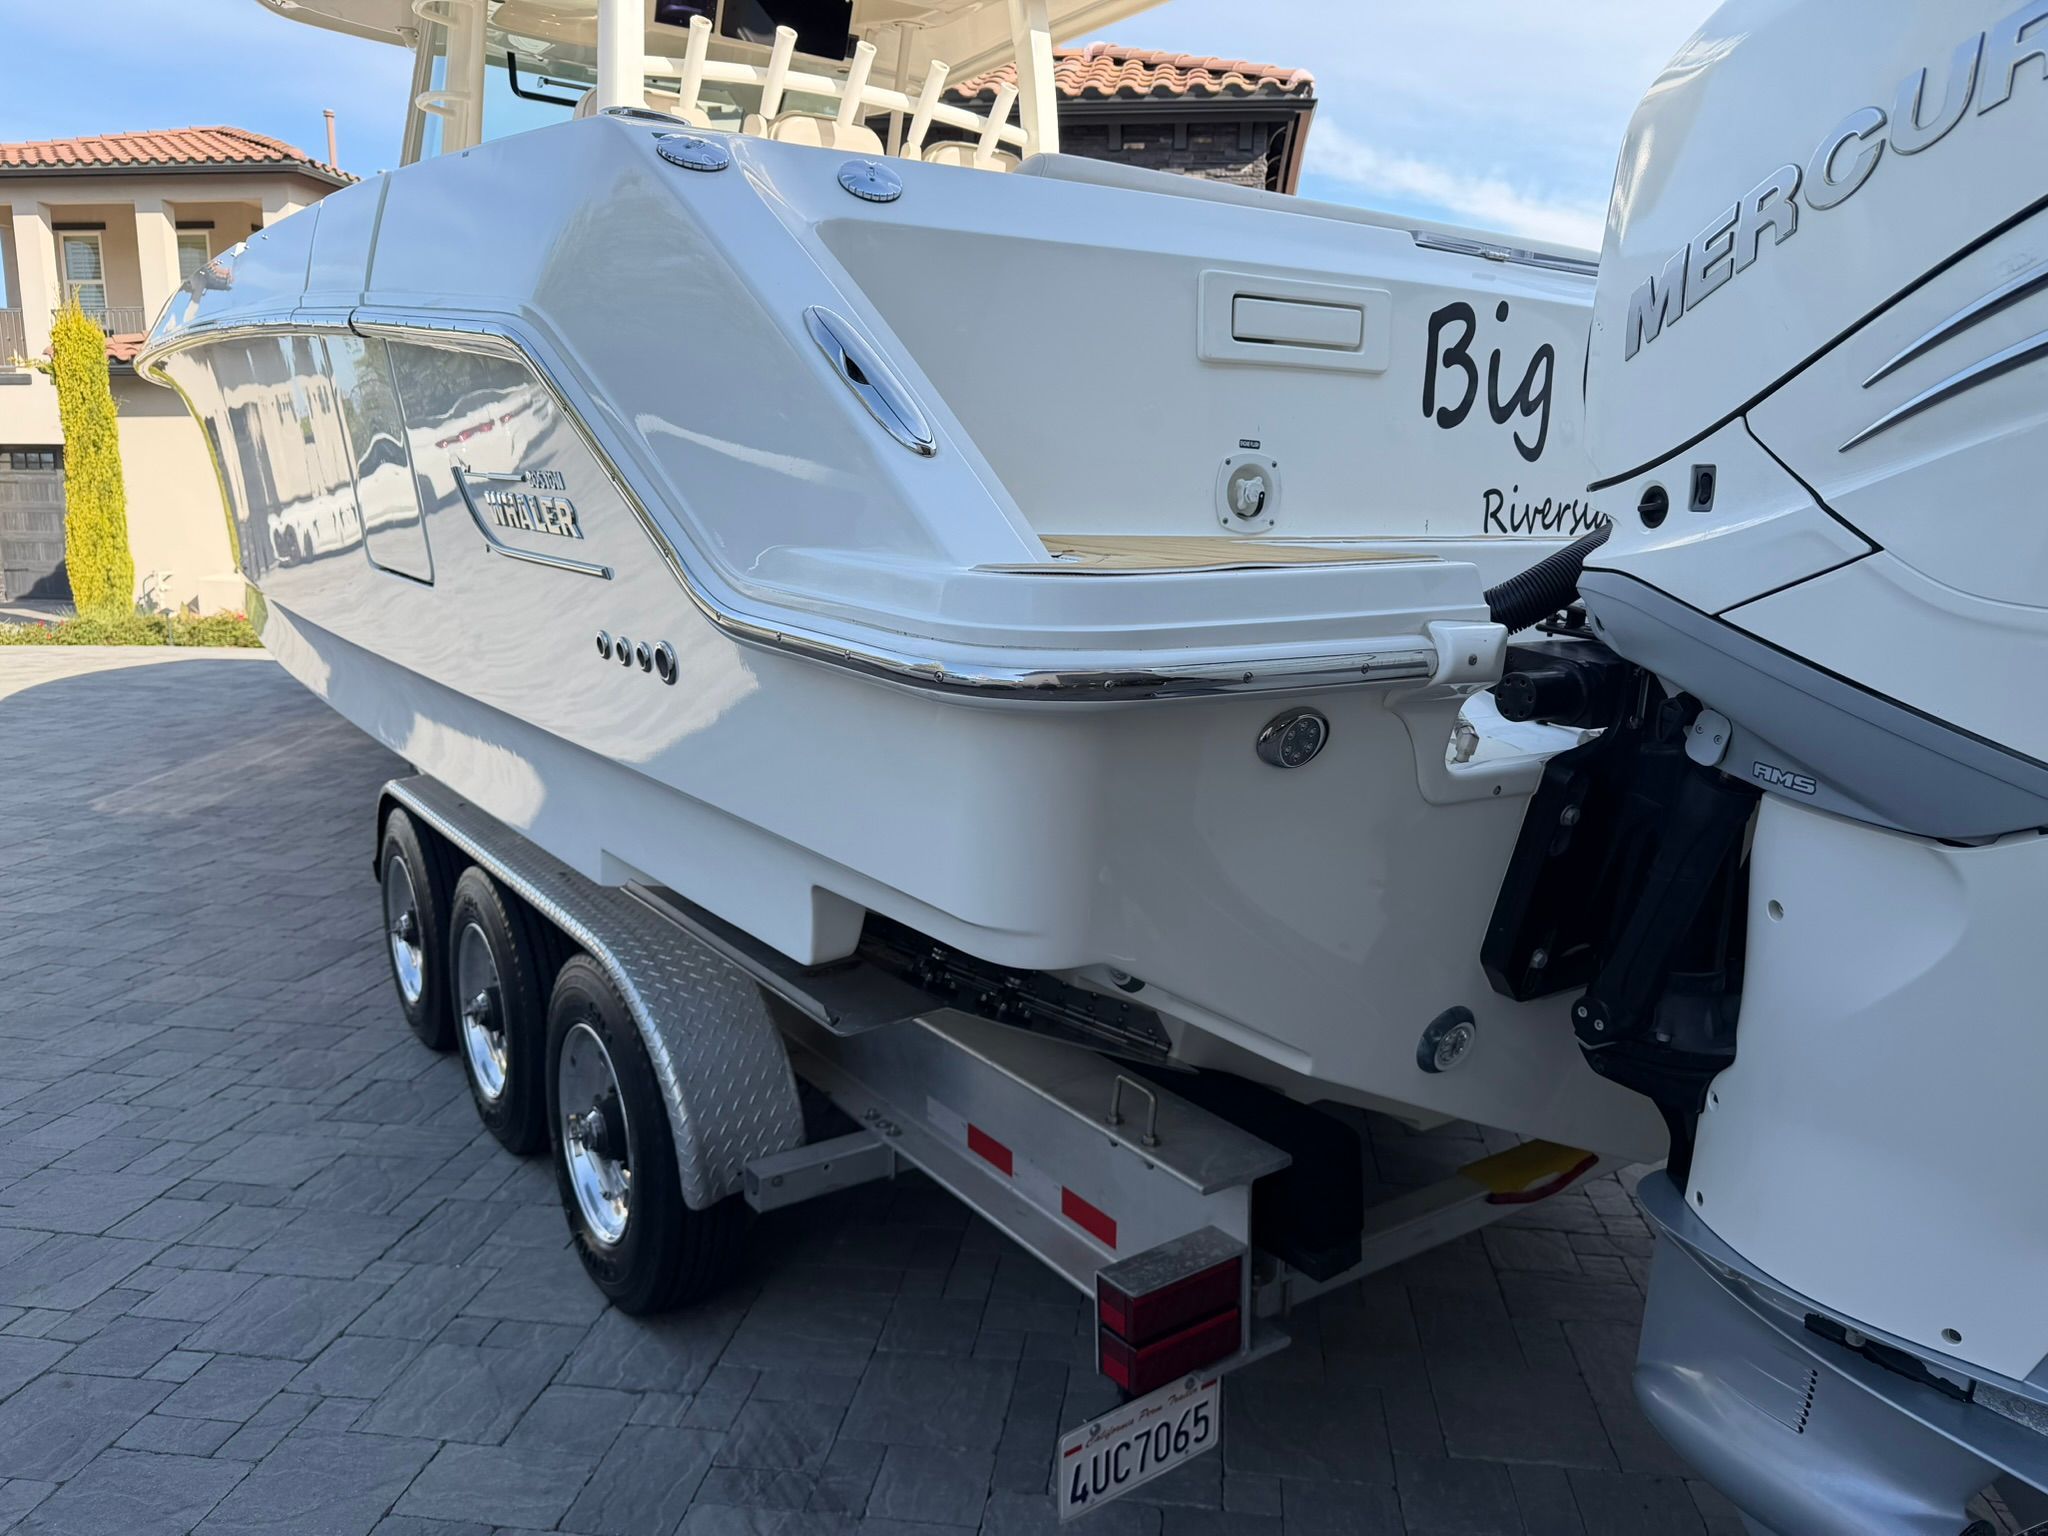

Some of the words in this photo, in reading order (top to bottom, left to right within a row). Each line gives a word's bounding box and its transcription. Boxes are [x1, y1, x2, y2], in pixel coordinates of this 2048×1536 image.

[1422, 300, 1556, 463] Big
[525, 470, 566, 490] BOSTON
[484, 490, 584, 539] WHALER
[1752, 761, 1817, 795] AMS
[1070, 1400, 1209, 1504] 4UC7065
